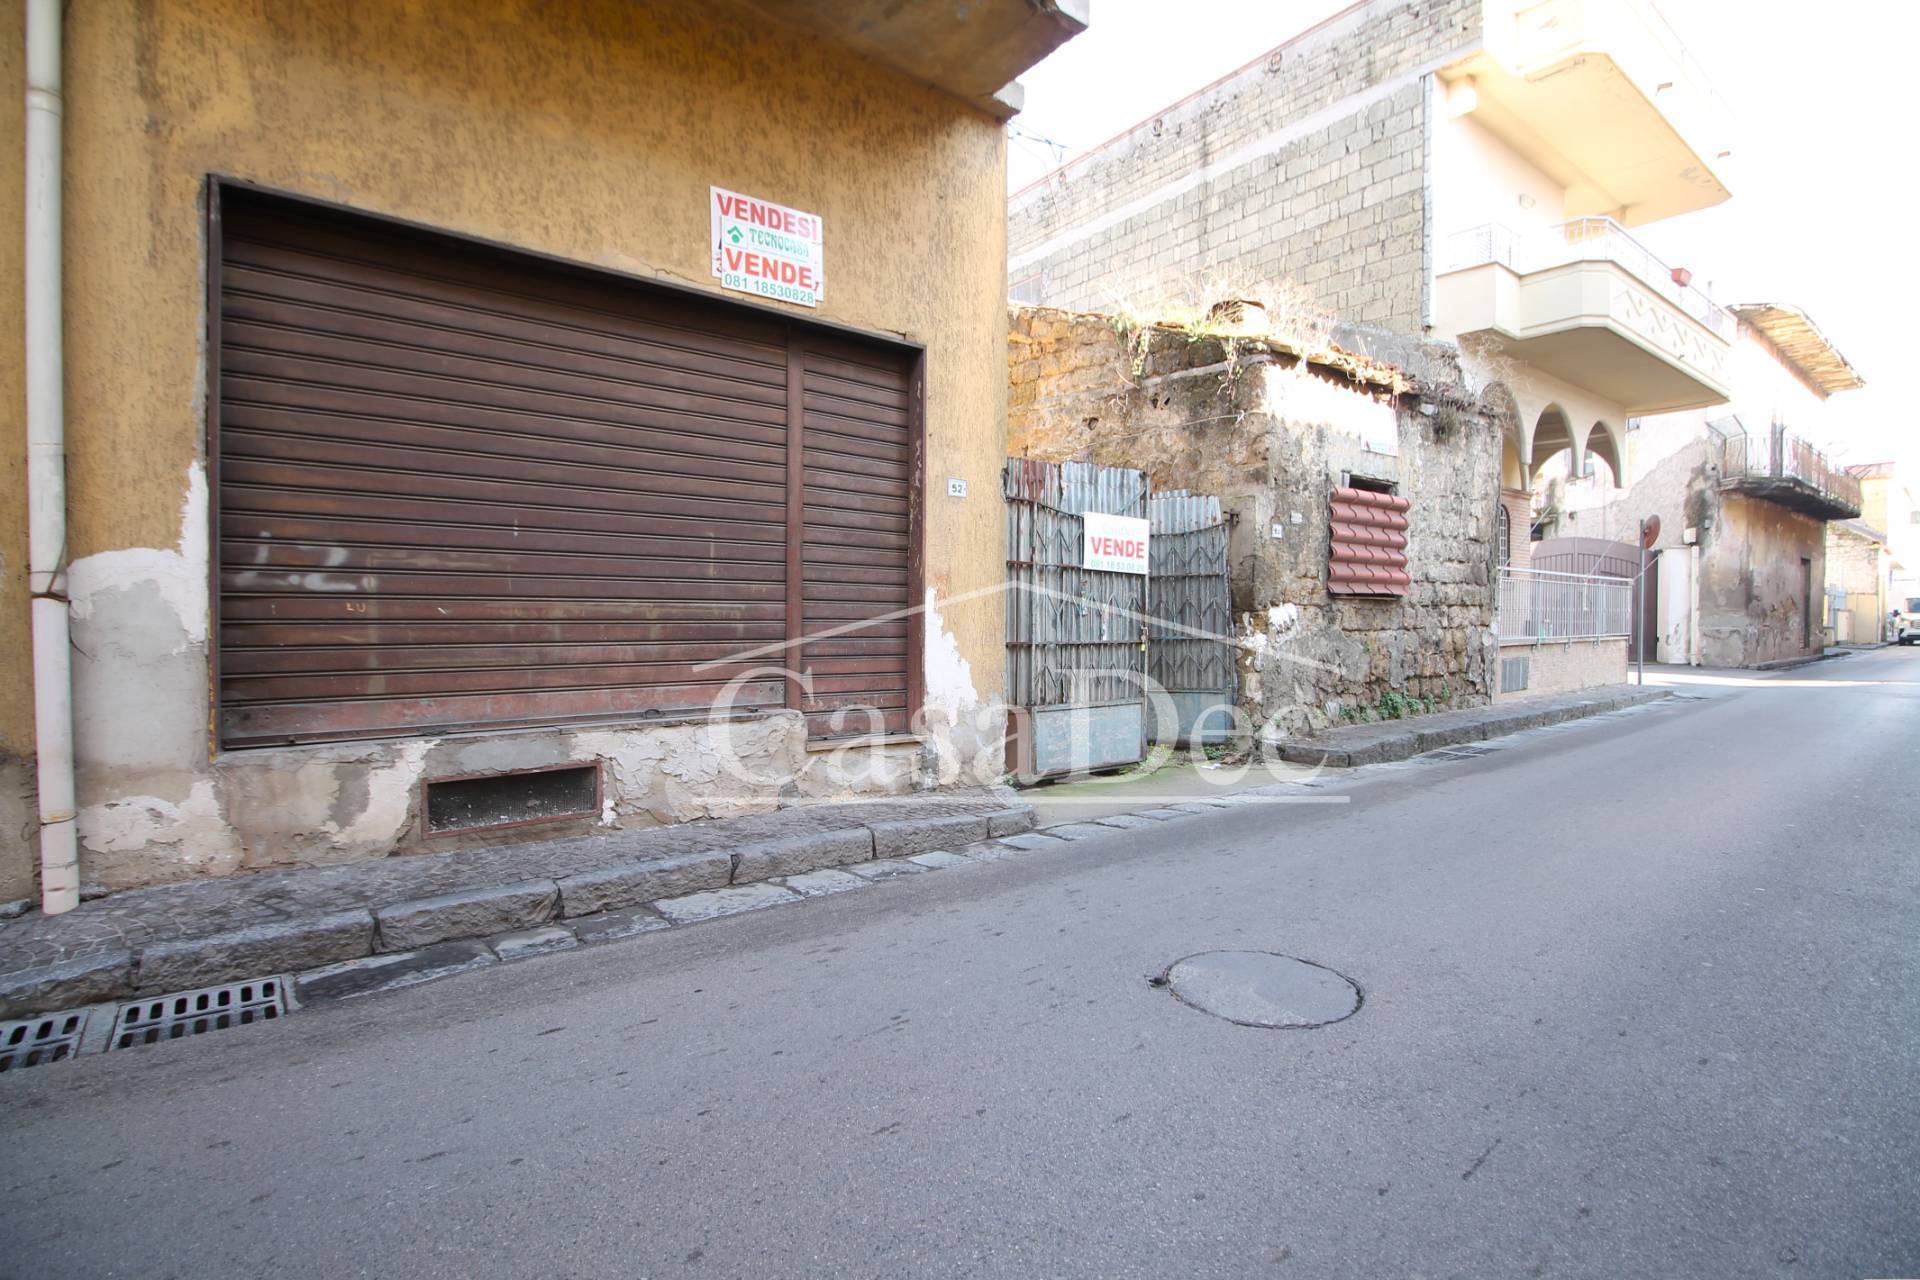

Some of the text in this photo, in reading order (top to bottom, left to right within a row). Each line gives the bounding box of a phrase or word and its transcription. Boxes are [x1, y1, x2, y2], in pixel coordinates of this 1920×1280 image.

[716, 192, 818, 241] VENDESI
[725, 247, 812, 289] VENDE
[725, 273, 748, 289] 081
[1090, 536, 1145, 559] VENDE
